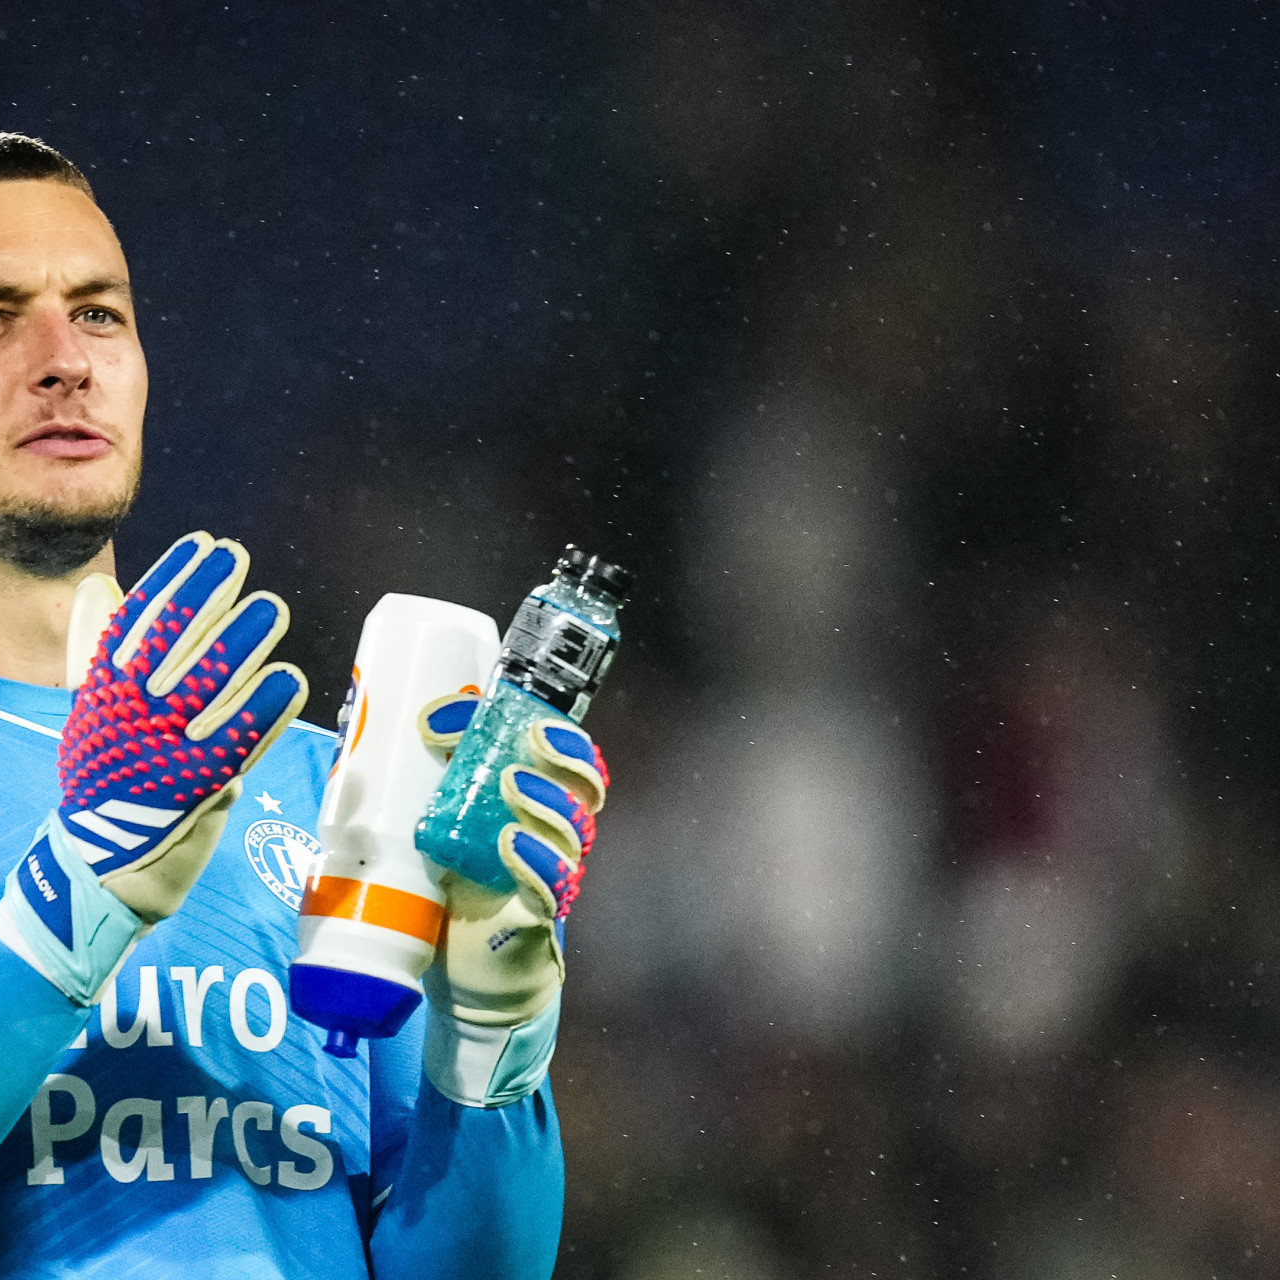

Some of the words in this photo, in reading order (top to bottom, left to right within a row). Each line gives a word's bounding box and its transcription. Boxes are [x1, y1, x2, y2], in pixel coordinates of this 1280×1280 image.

[249, 824, 321, 855] FEYENOOR
[70, 965, 288, 1052] uro
[27, 1073, 334, 1191] Parcs
